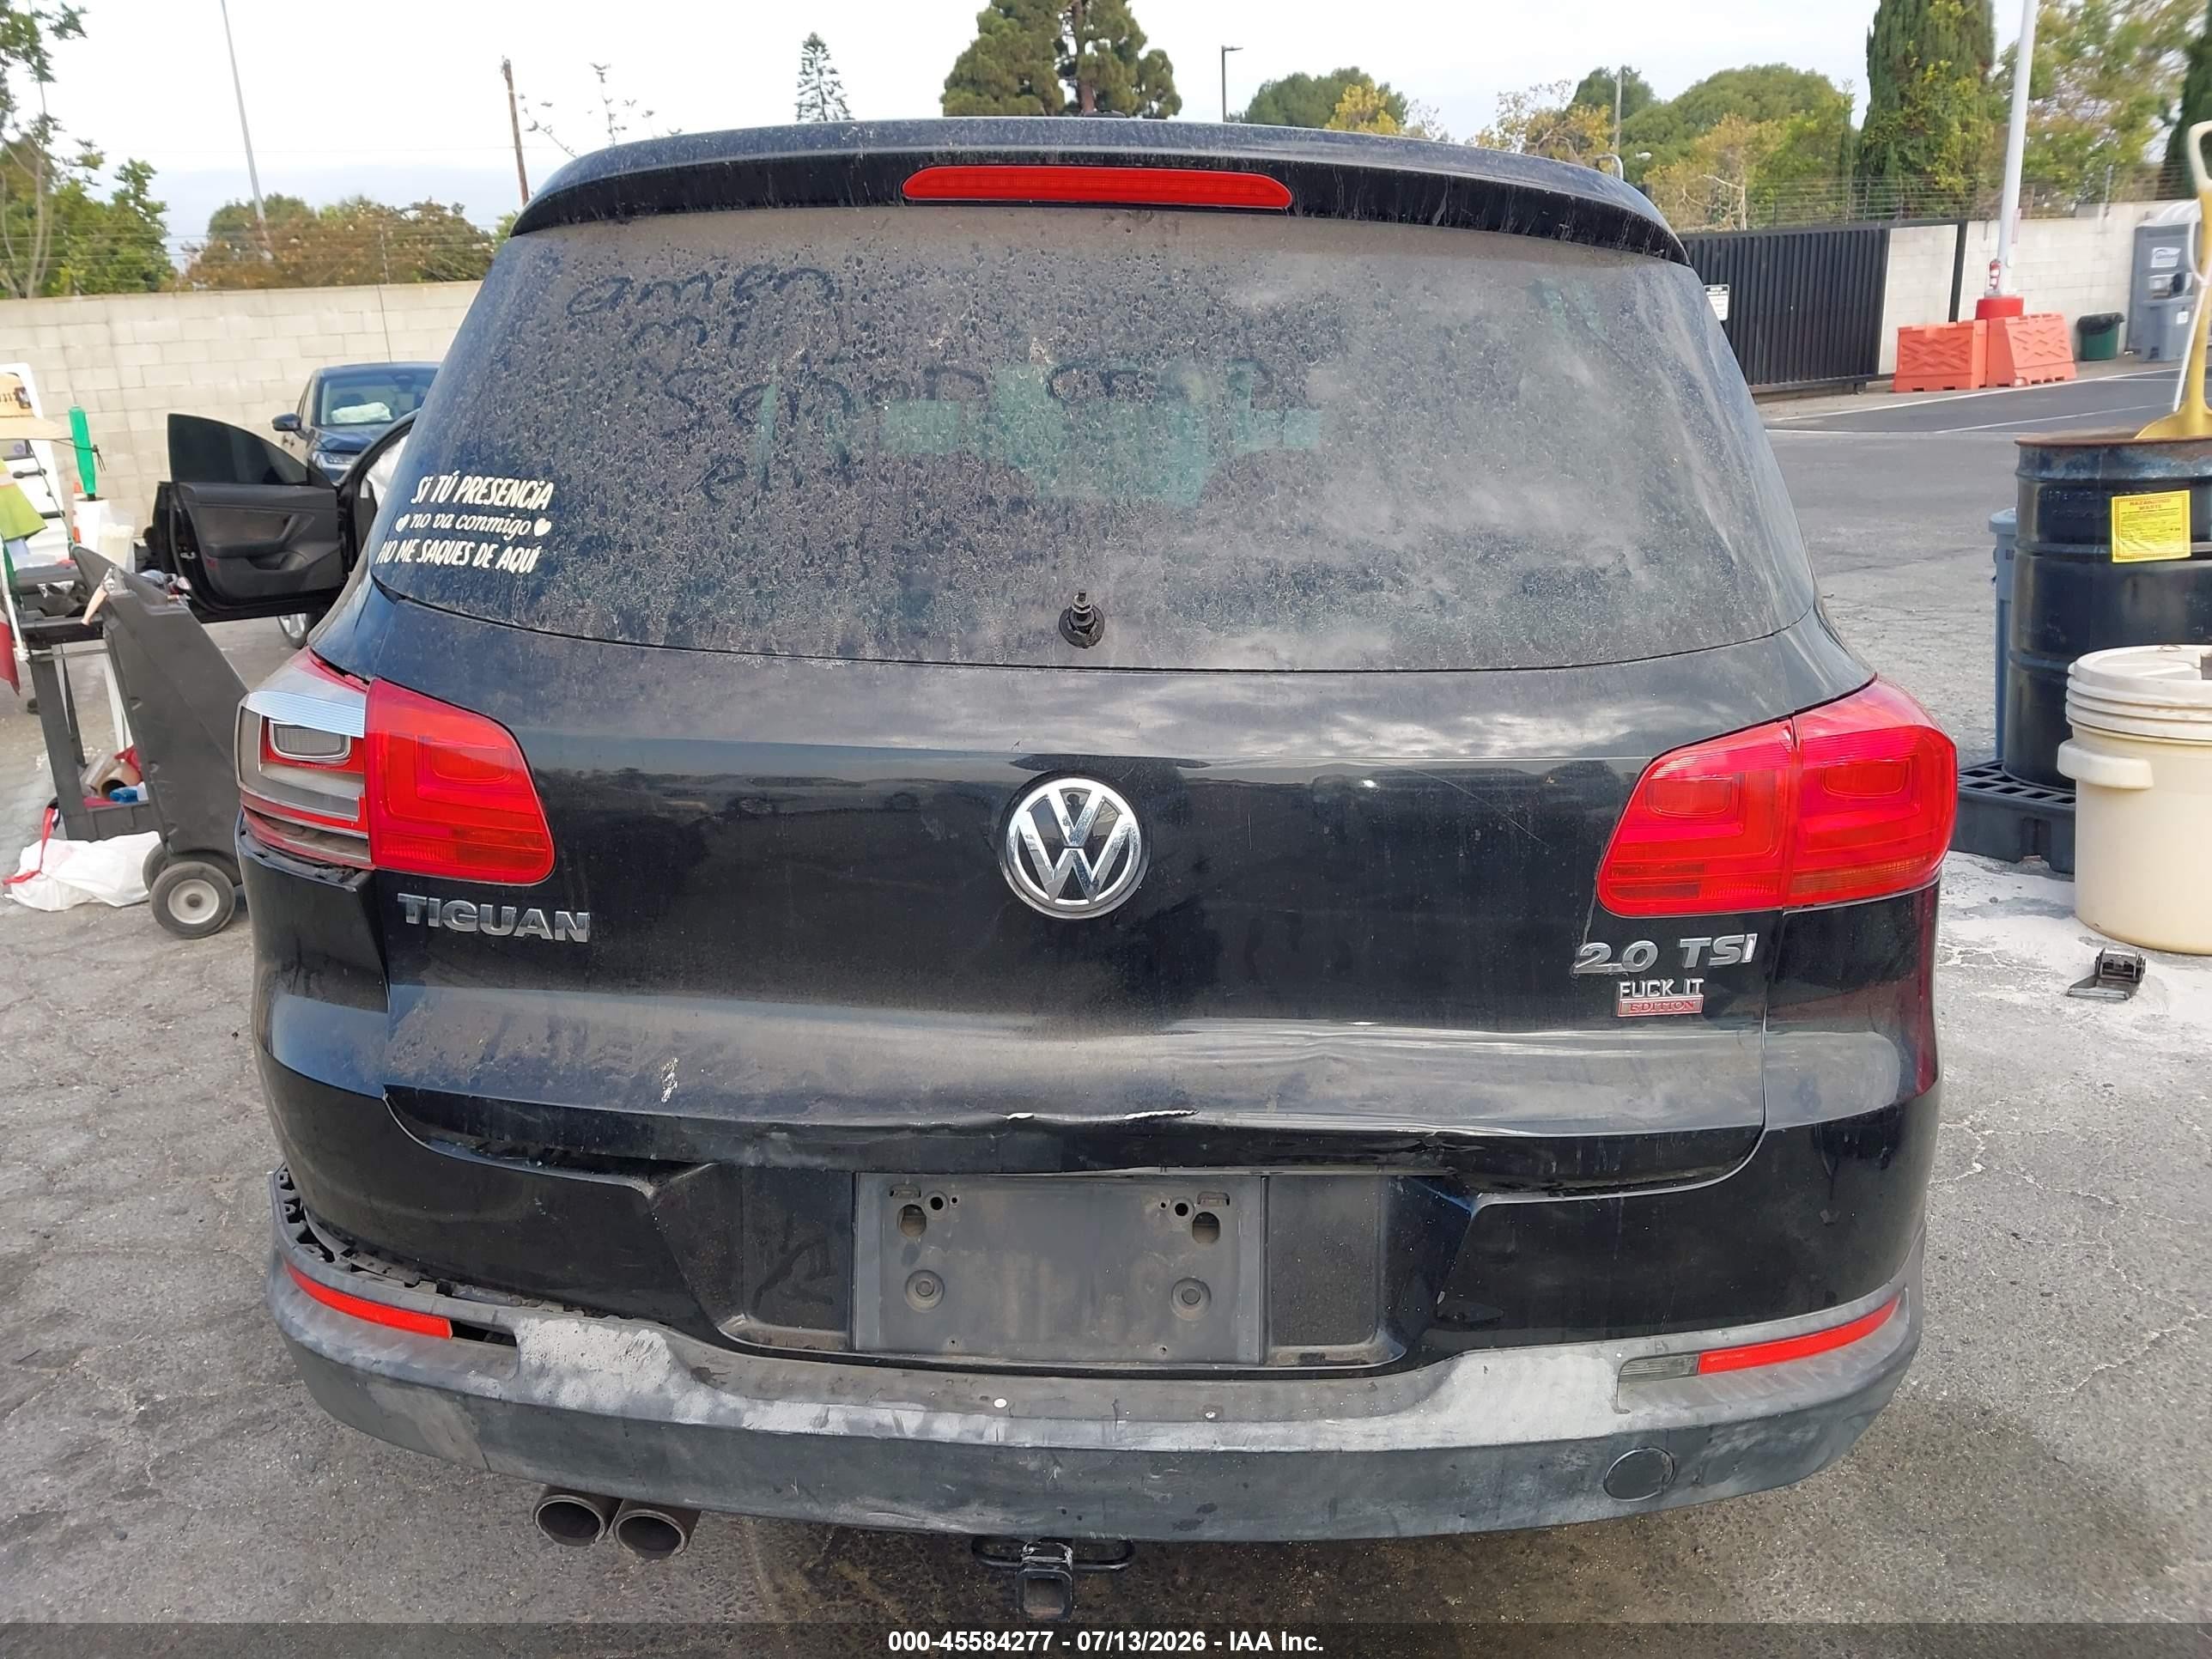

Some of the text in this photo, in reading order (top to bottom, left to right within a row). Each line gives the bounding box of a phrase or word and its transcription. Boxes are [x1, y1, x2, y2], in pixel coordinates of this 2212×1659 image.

[410, 513, 532, 541] no va conmigo
[375, 538, 543, 574] NO ME SAQUES DE AQUÍ
[1006, 777, 1142, 914] VW
[398, 892, 591, 943] TIGUAN
[1573, 933, 1759, 975] 2.0 TSI
[1619, 977, 1705, 999] FUCK IT
[1629, 999, 1696, 1013] EDITION
